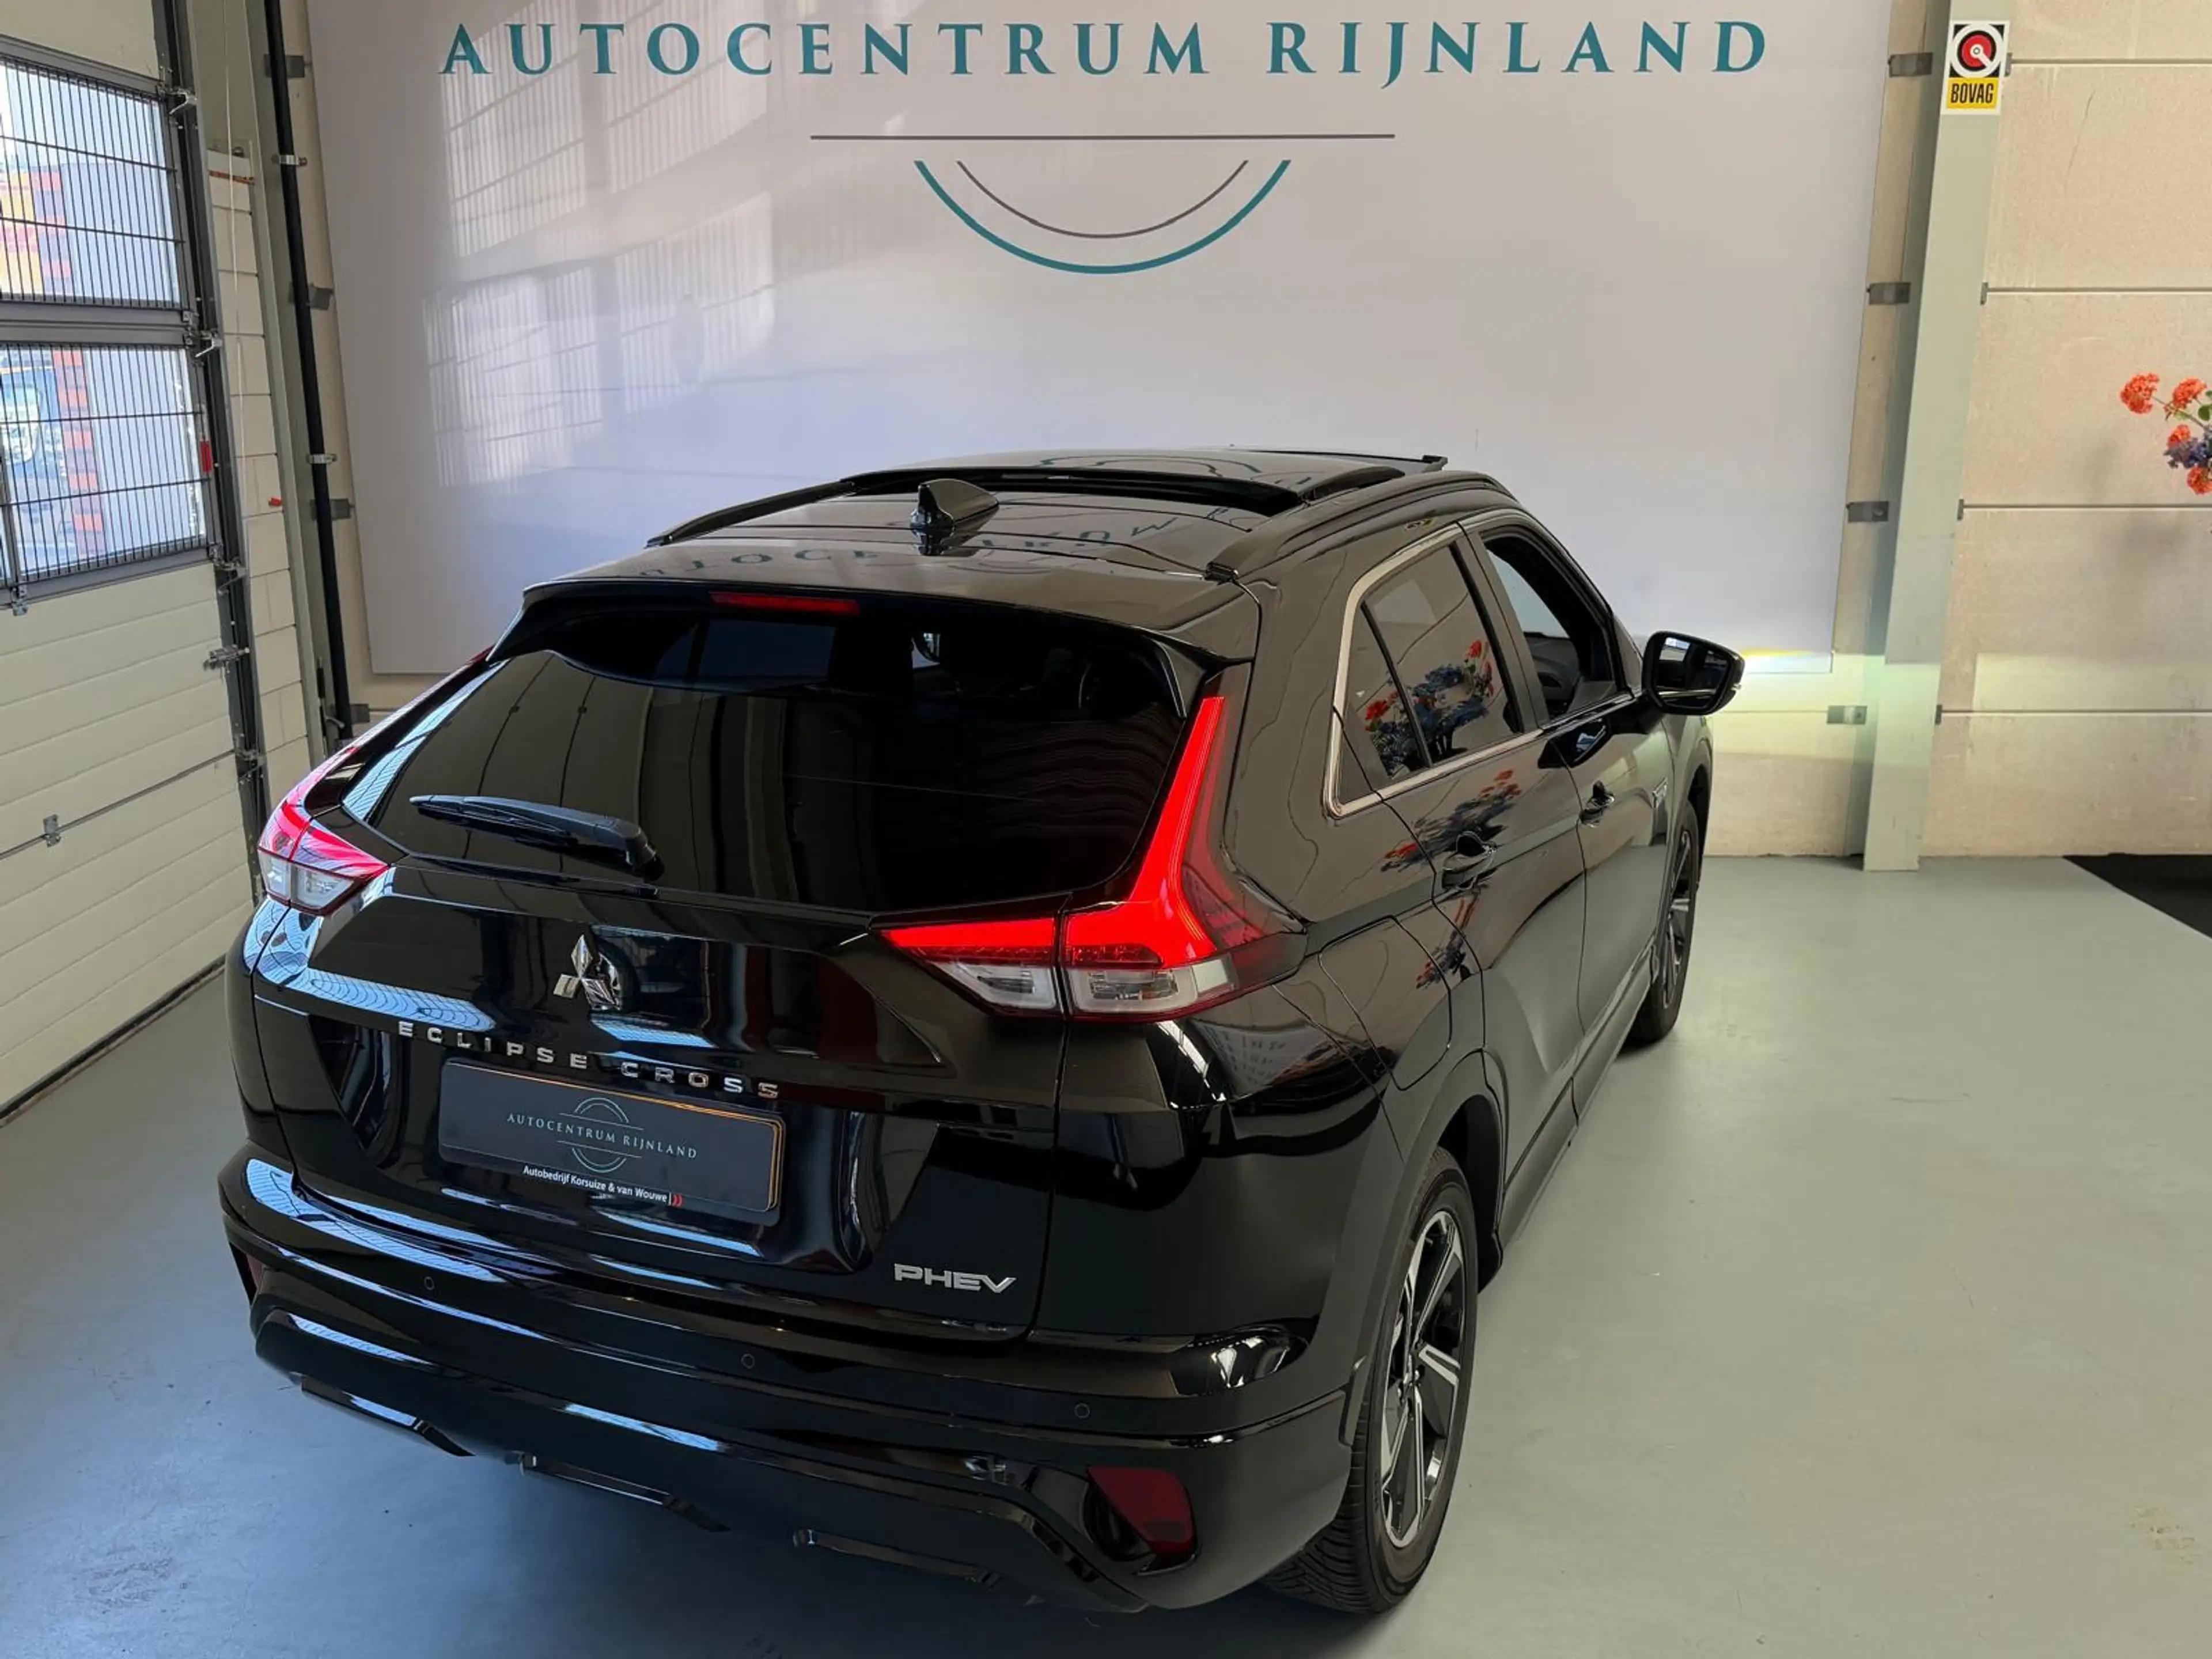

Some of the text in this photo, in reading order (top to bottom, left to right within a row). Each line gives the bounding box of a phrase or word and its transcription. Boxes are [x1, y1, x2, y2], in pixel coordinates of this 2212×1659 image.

[438, 21, 1766, 89] AUTOCENTRUM RIJNLAND
[1951, 83, 1994, 103] BOVAG
[398, 1021, 779, 1099] ECLIPSE CROSS
[506, 1113, 698, 1160] AUTOCENTRUM RIJNLAND
[522, 1165, 668, 1203] Autobedrijf Korsuize & van Wouwe
[894, 1263, 1016, 1294] PHEV
